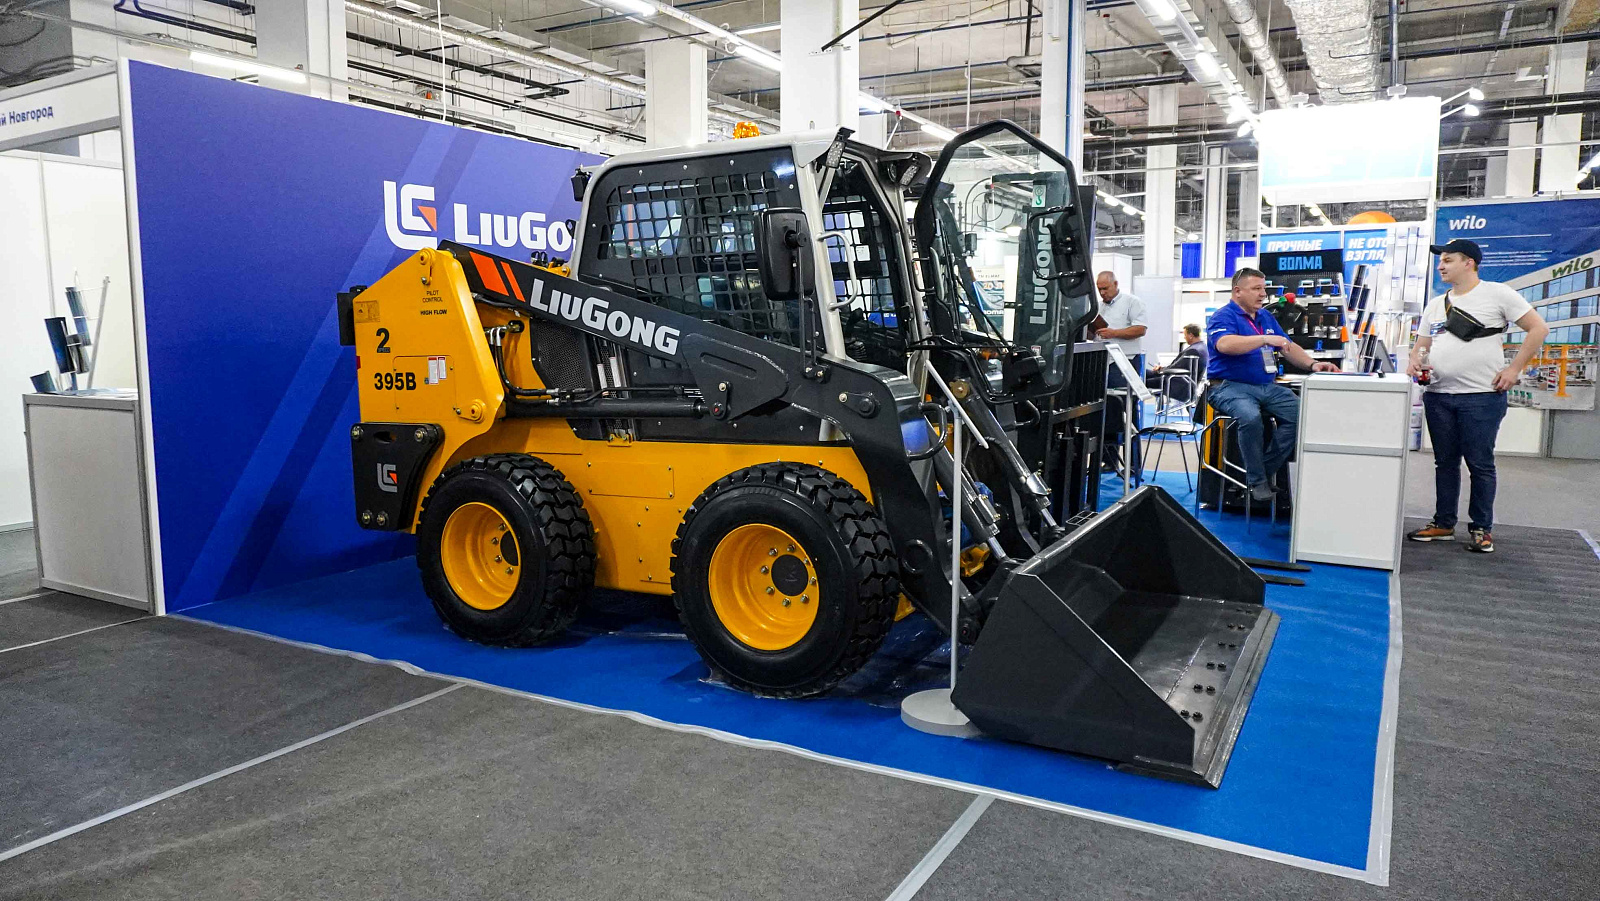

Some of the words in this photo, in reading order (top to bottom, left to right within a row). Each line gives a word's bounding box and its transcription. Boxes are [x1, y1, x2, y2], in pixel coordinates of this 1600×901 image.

[9, 106, 54, 124] Новгород
[1450, 215, 1487, 230] wilo
[1267, 239, 1323, 252] ПРОЧНЫЕ
[1348, 238, 1366, 249] НЕ
[1278, 255, 1323, 271] ВОЛМА
[1345, 249, 1387, 262] ВЗГЛЯ
[1552, 257, 1594, 279] wilo
[376, 328, 391, 353] 2
[374, 372, 417, 391] 395B
